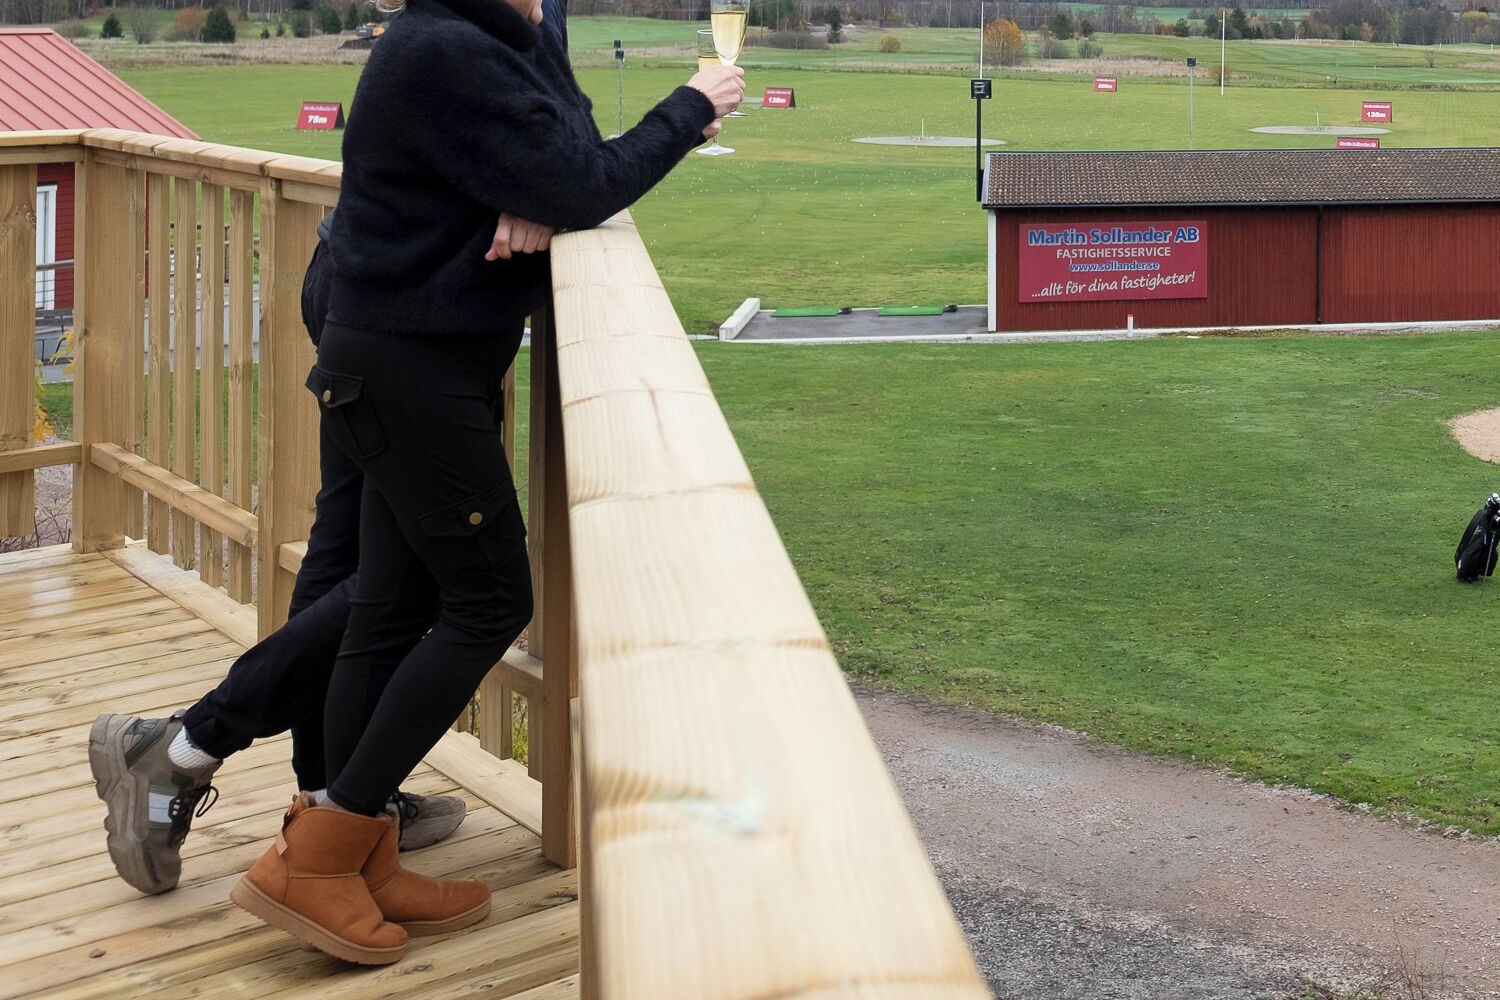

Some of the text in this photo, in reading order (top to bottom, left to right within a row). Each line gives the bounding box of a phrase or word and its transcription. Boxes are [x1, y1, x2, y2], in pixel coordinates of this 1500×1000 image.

[1028, 227, 1199, 246] Martin Sollander AB
[1056, 247, 1171, 259] FASTIGHETSSERVICE
[1069, 261, 1160, 272] www.sollander.se
[1031, 271, 1196, 298] ...allt för dina fastigheter!
